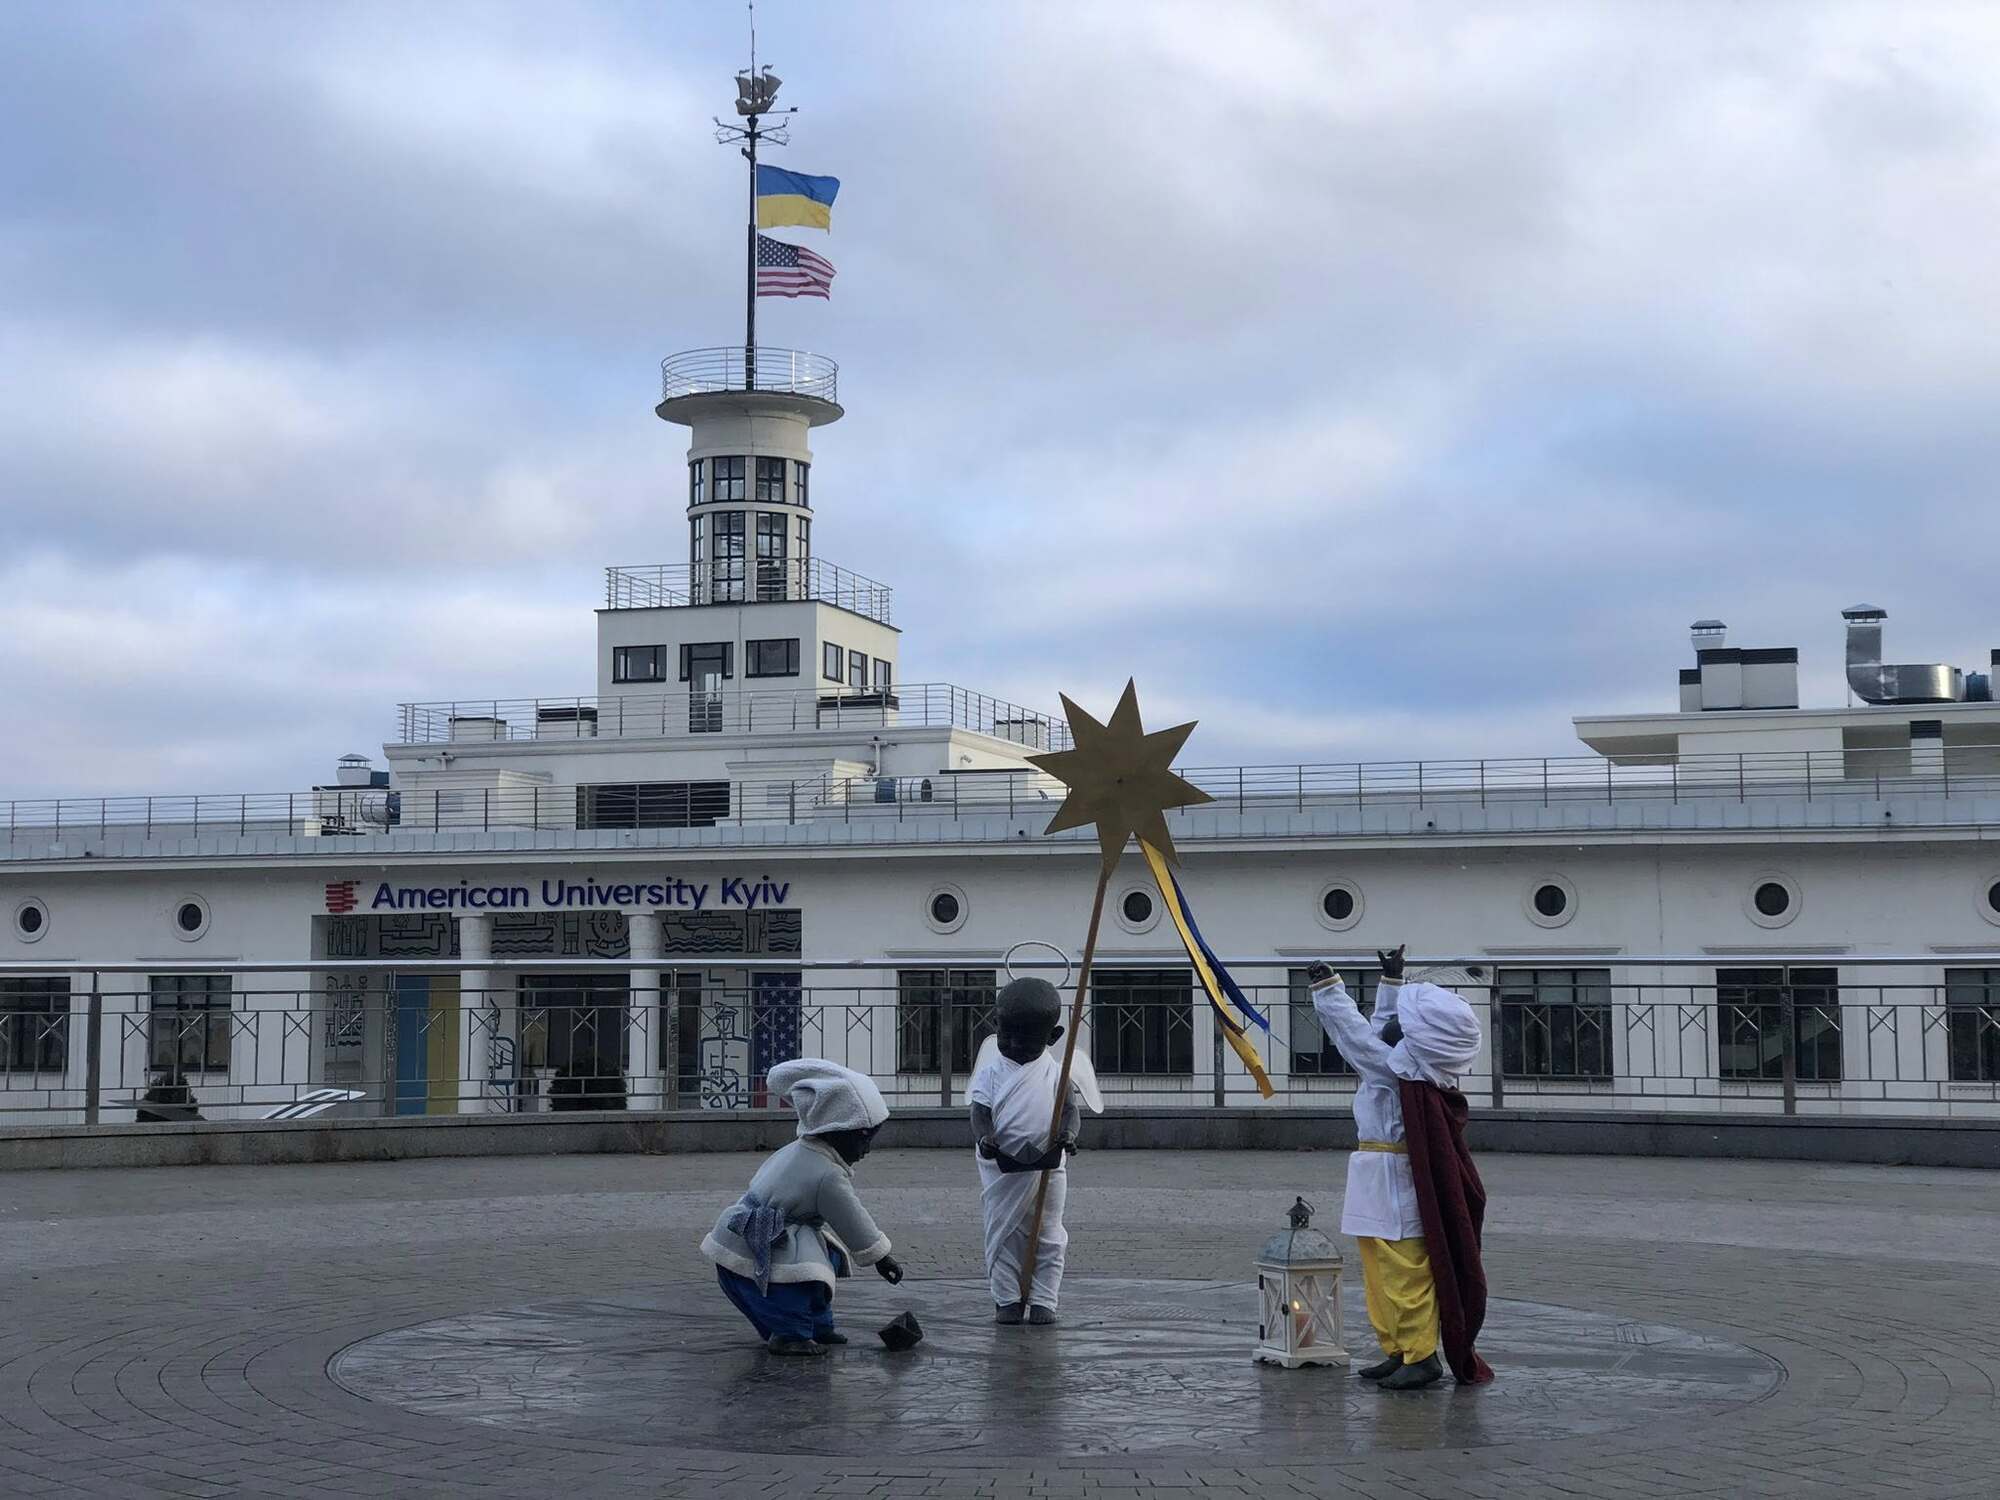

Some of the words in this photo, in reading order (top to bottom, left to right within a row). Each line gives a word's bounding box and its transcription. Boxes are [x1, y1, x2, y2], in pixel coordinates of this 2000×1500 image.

[371, 880, 529, 909] American
[542, 877, 708, 910] University
[721, 876, 790, 909] Kyiv
